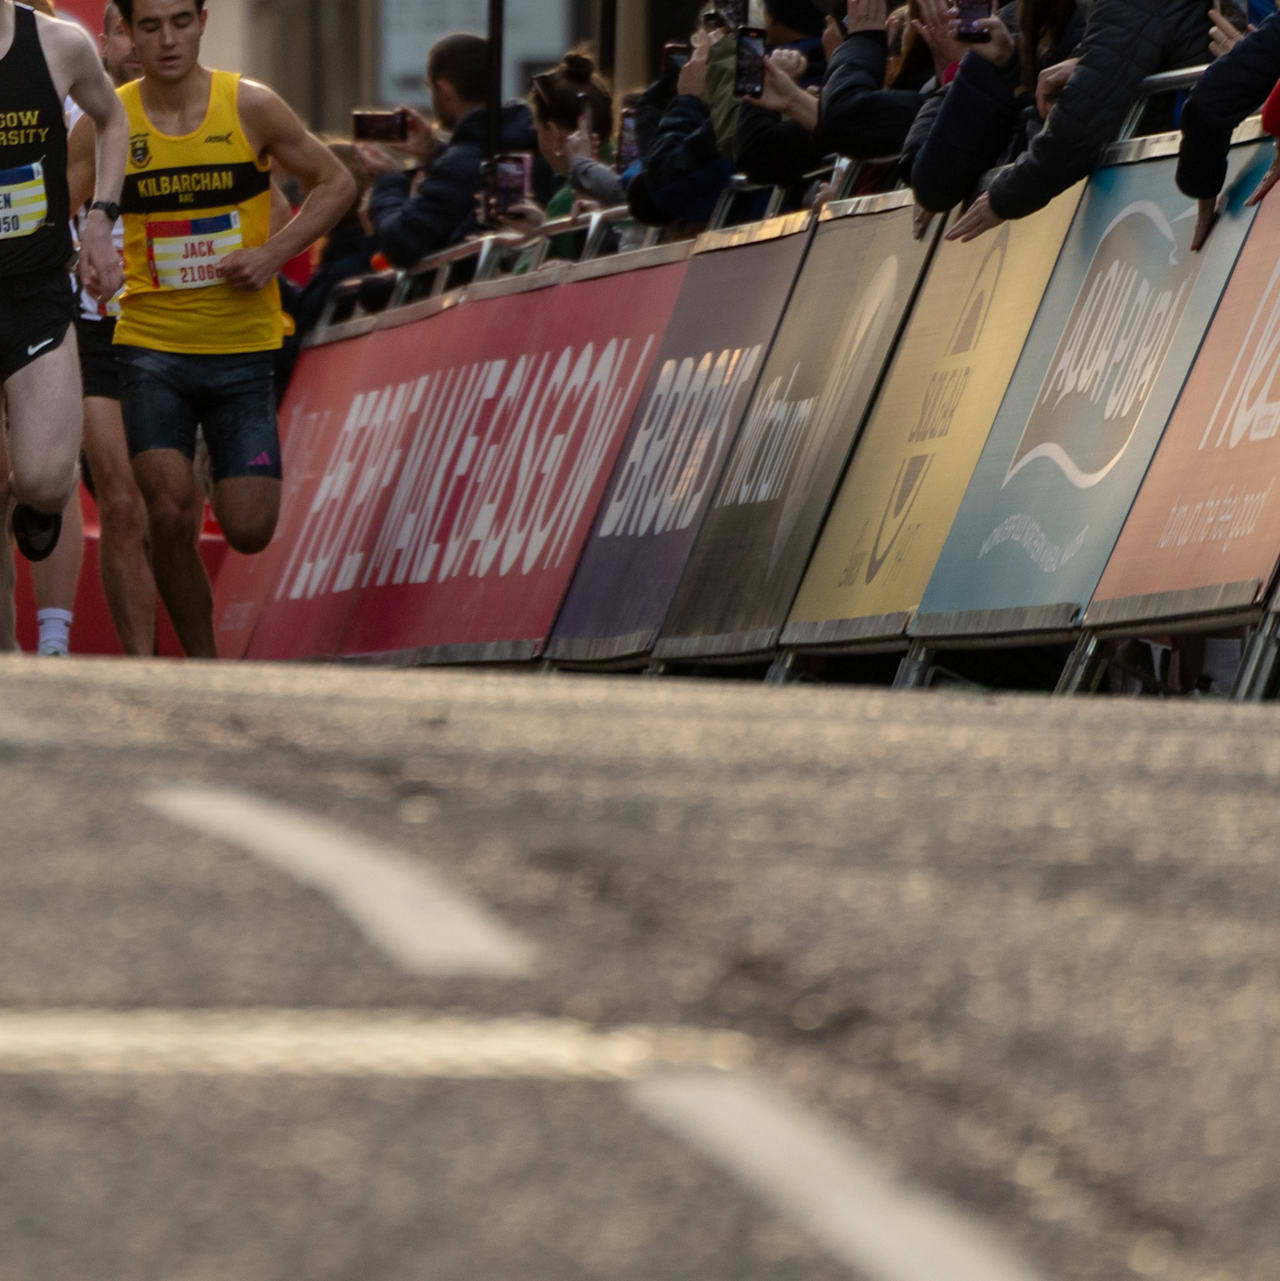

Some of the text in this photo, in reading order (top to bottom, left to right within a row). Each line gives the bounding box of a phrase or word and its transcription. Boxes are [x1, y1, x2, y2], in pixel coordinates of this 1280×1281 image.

[137, 170, 233, 198] KILBARCHAN
[182, 239, 216, 259] JACK
[1041, 259, 1138, 414] AQUA
[1102, 275, 1193, 419] PURA
[598, 343, 763, 537] BROOKS
